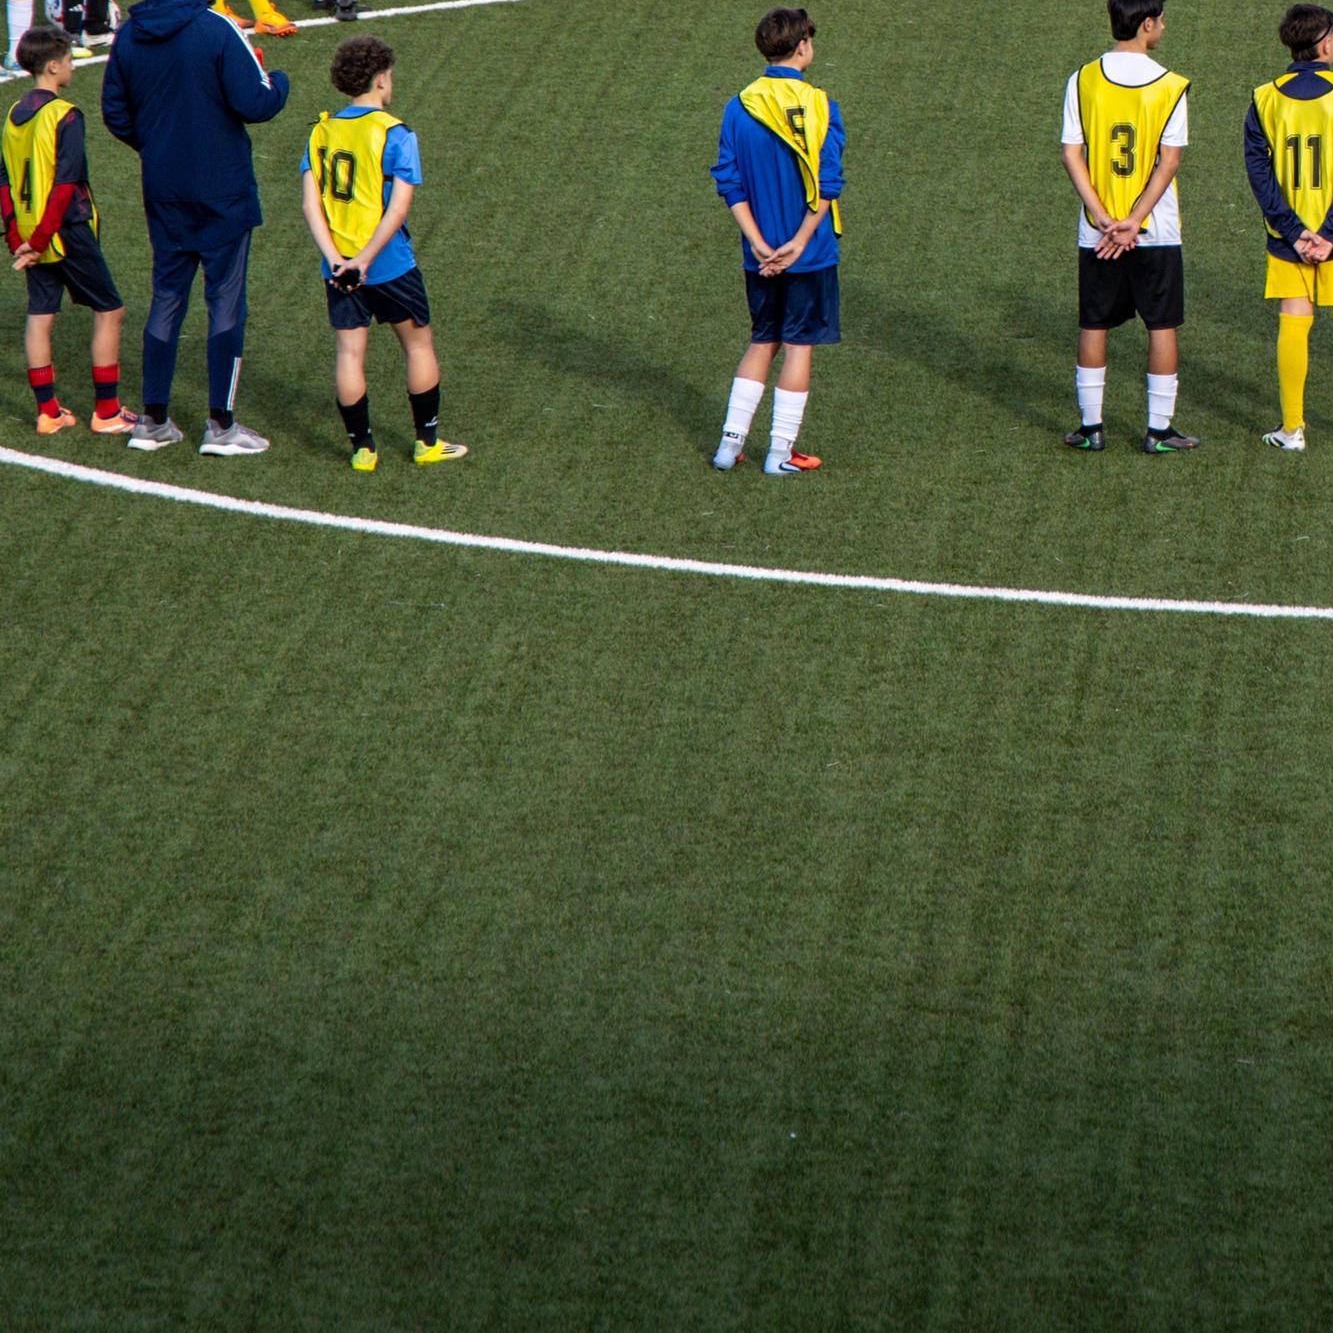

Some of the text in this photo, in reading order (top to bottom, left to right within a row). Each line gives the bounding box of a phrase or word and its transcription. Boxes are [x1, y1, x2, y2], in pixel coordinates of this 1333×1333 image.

[317, 146, 357, 205] 10
[1109, 123, 1137, 178] 3
[1285, 134, 1322, 190] 11
[19, 157, 34, 214] 4
